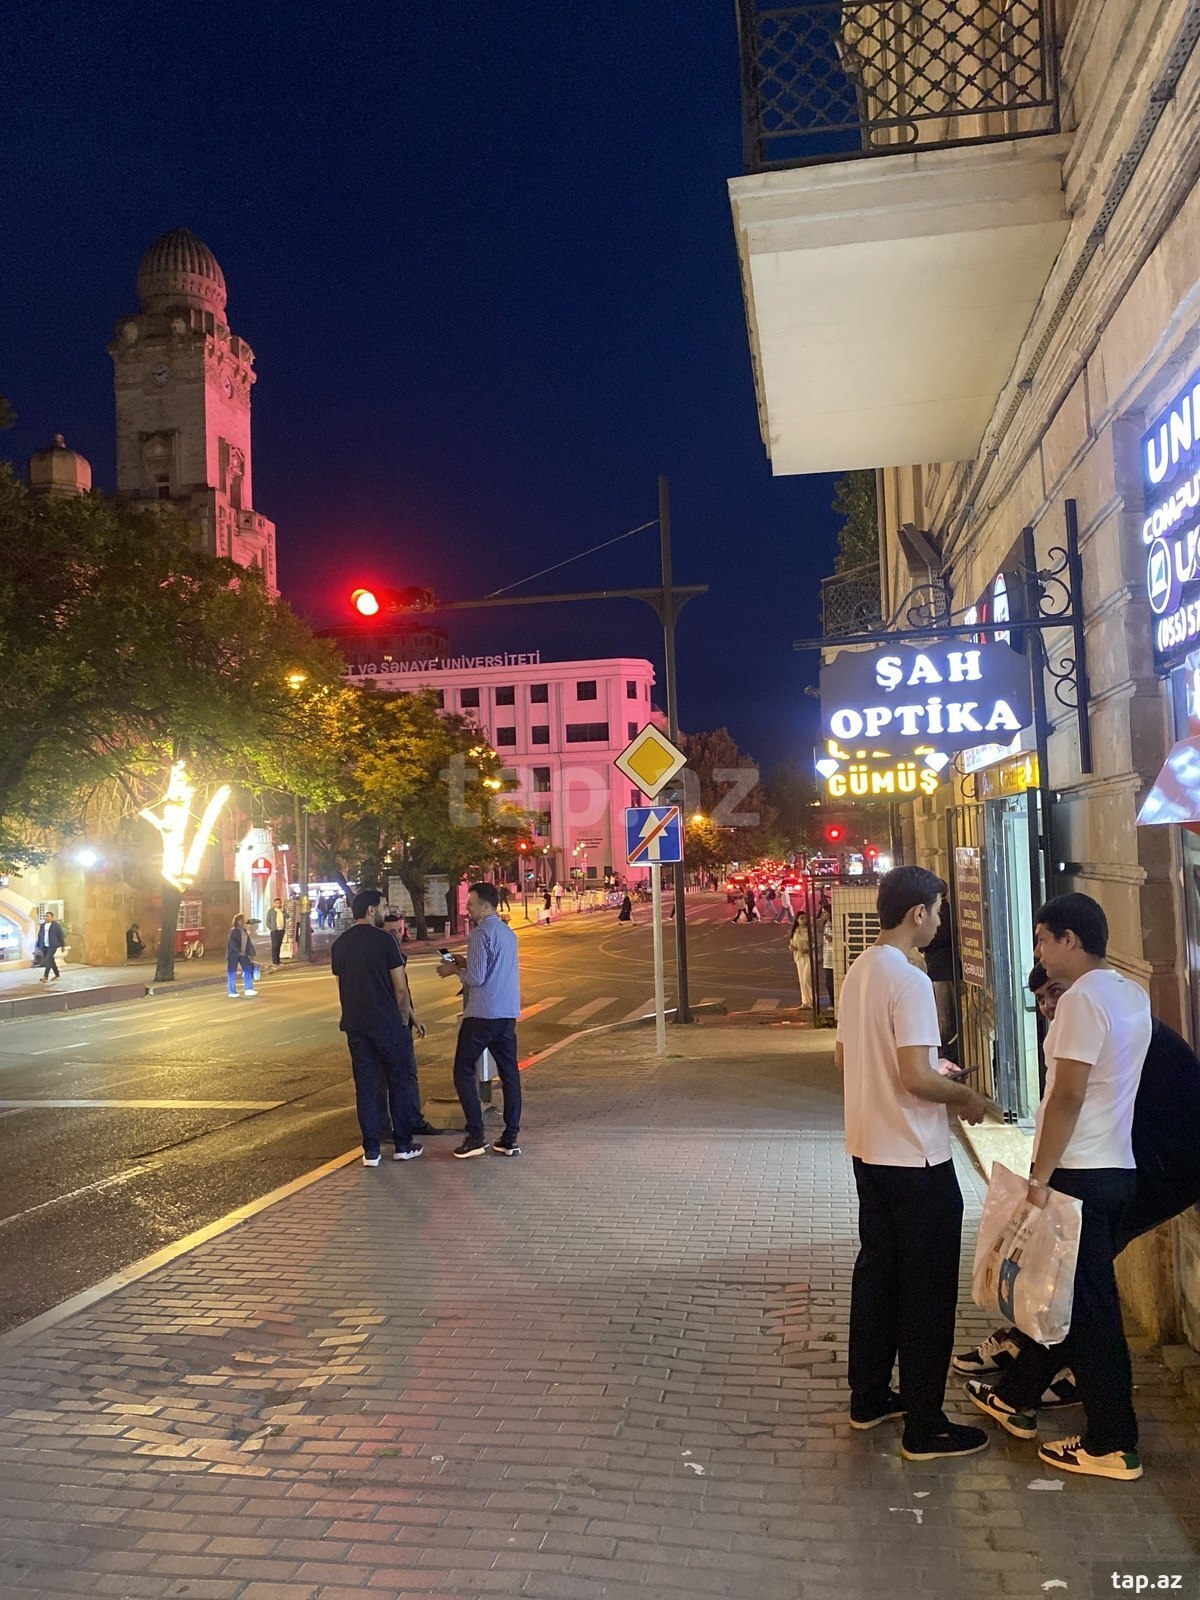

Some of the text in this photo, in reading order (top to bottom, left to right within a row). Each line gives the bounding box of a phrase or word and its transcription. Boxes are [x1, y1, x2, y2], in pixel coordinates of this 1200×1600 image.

[1143, 466, 1200, 544] COMPU
[358, 663, 377, 675] VƏ
[381, 659, 437, 674] SƏNAYE
[441, 649, 540, 670] UNİVERSİTETİ
[876, 650, 982, 692] ŞAH
[830, 697, 1021, 739] OPTİKA
[828, 763, 938, 796] GÜMÜŞ
